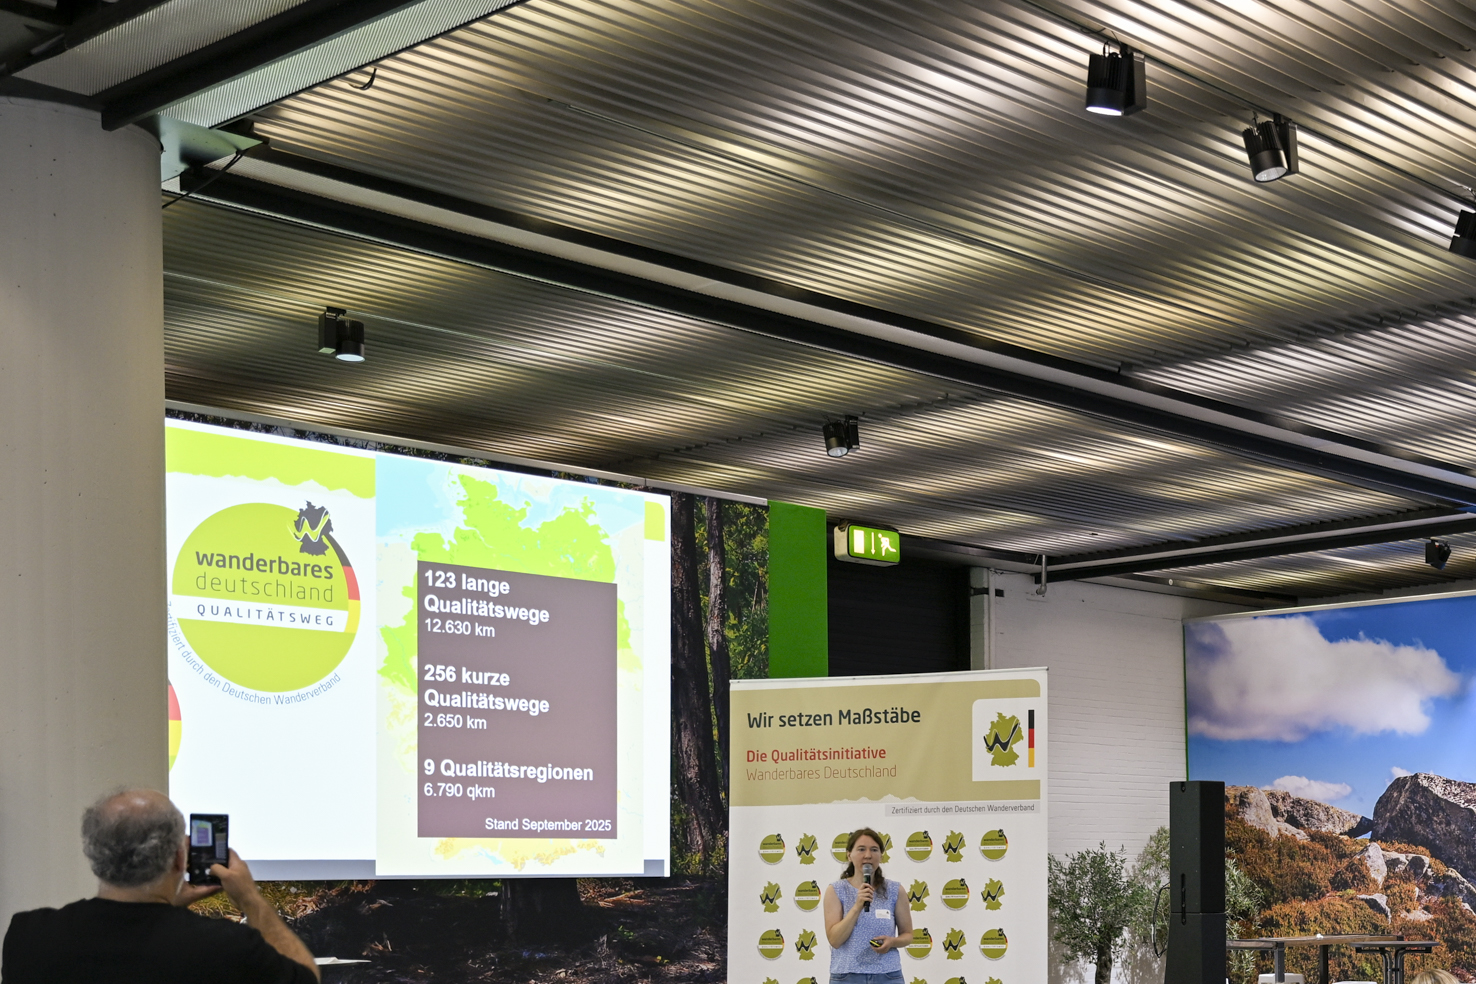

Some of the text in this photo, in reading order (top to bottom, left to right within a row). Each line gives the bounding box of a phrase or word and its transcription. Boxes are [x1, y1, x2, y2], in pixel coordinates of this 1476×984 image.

[195, 550, 334, 580] wanderbares
[195, 571, 334, 603] deutschland
[424, 569, 511, 598] 123 lange
[196, 603, 334, 626] QUALITÄTSWEG
[423, 593, 550, 626] Qualitätswege
[424, 617, 496, 638] 12.630 km
[181, 649, 205, 675] durch
[203, 672, 221, 689] den
[221, 681, 272, 705] Deutschen
[273, 671, 342, 706] Wanderverband
[423, 664, 511, 687] 256 kurze
[423, 688, 550, 717] Qualitätswege
[423, 713, 488, 730] 2.650 km
[747, 706, 922, 729] Wir setzen Maßstäbe
[746, 746, 888, 765] Die Qualitätsinitiative
[423, 758, 594, 783] 9 Qualitätsregionen
[745, 764, 898, 782] Wanderbares Deutschland
[423, 782, 496, 801] 6.790 qkm
[891, 803, 1035, 815] Zertifiziert durch den Deutschen Wanderverband
[484, 817, 612, 834] Stand September 2025
